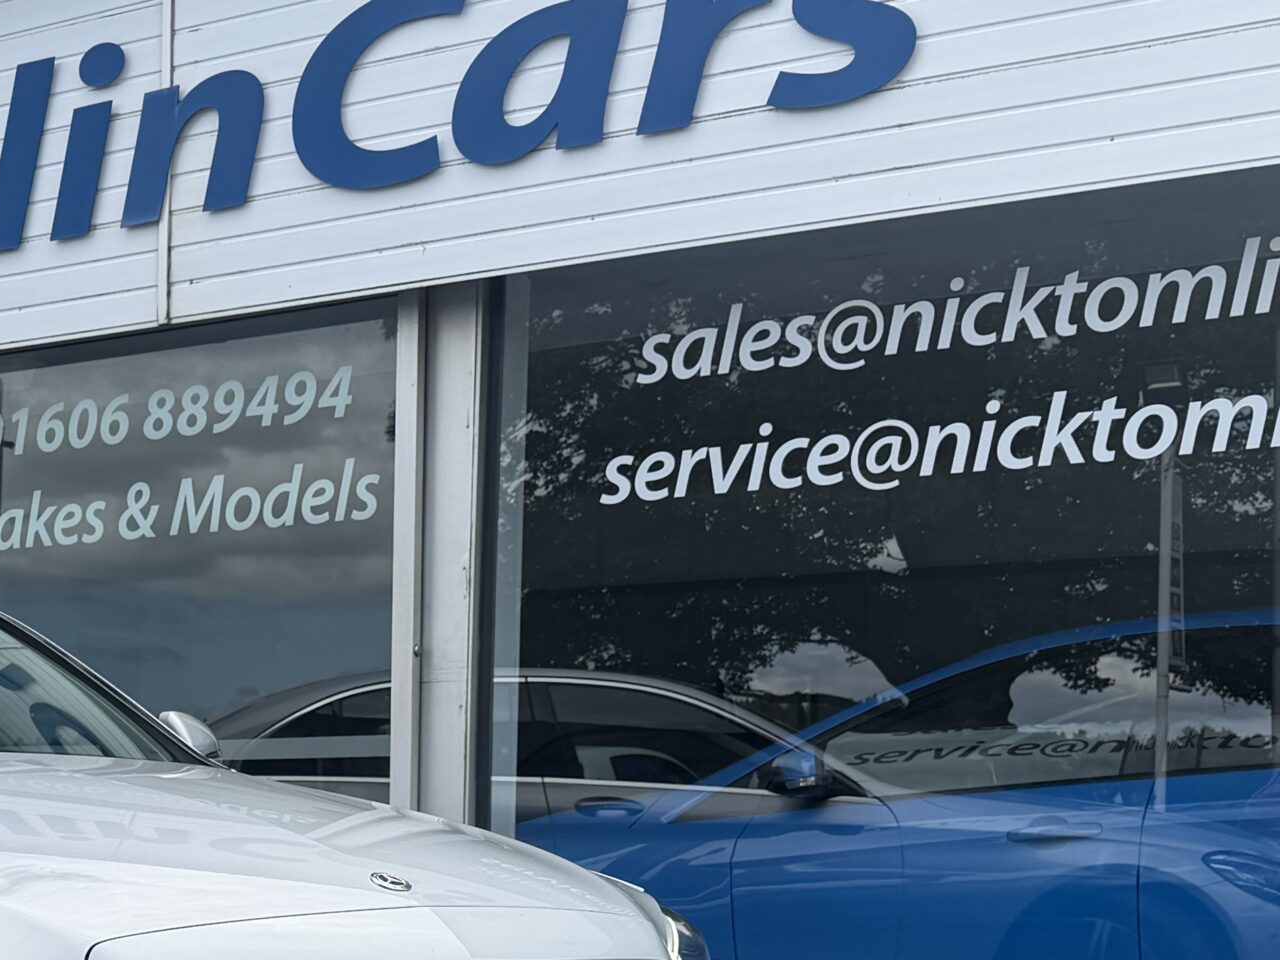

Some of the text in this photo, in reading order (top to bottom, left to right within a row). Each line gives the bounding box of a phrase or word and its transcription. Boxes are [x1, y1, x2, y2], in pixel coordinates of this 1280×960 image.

[142, 366, 354, 441] 889494
[119, 481, 159, 540] &
[170, 457, 380, 536] Models
